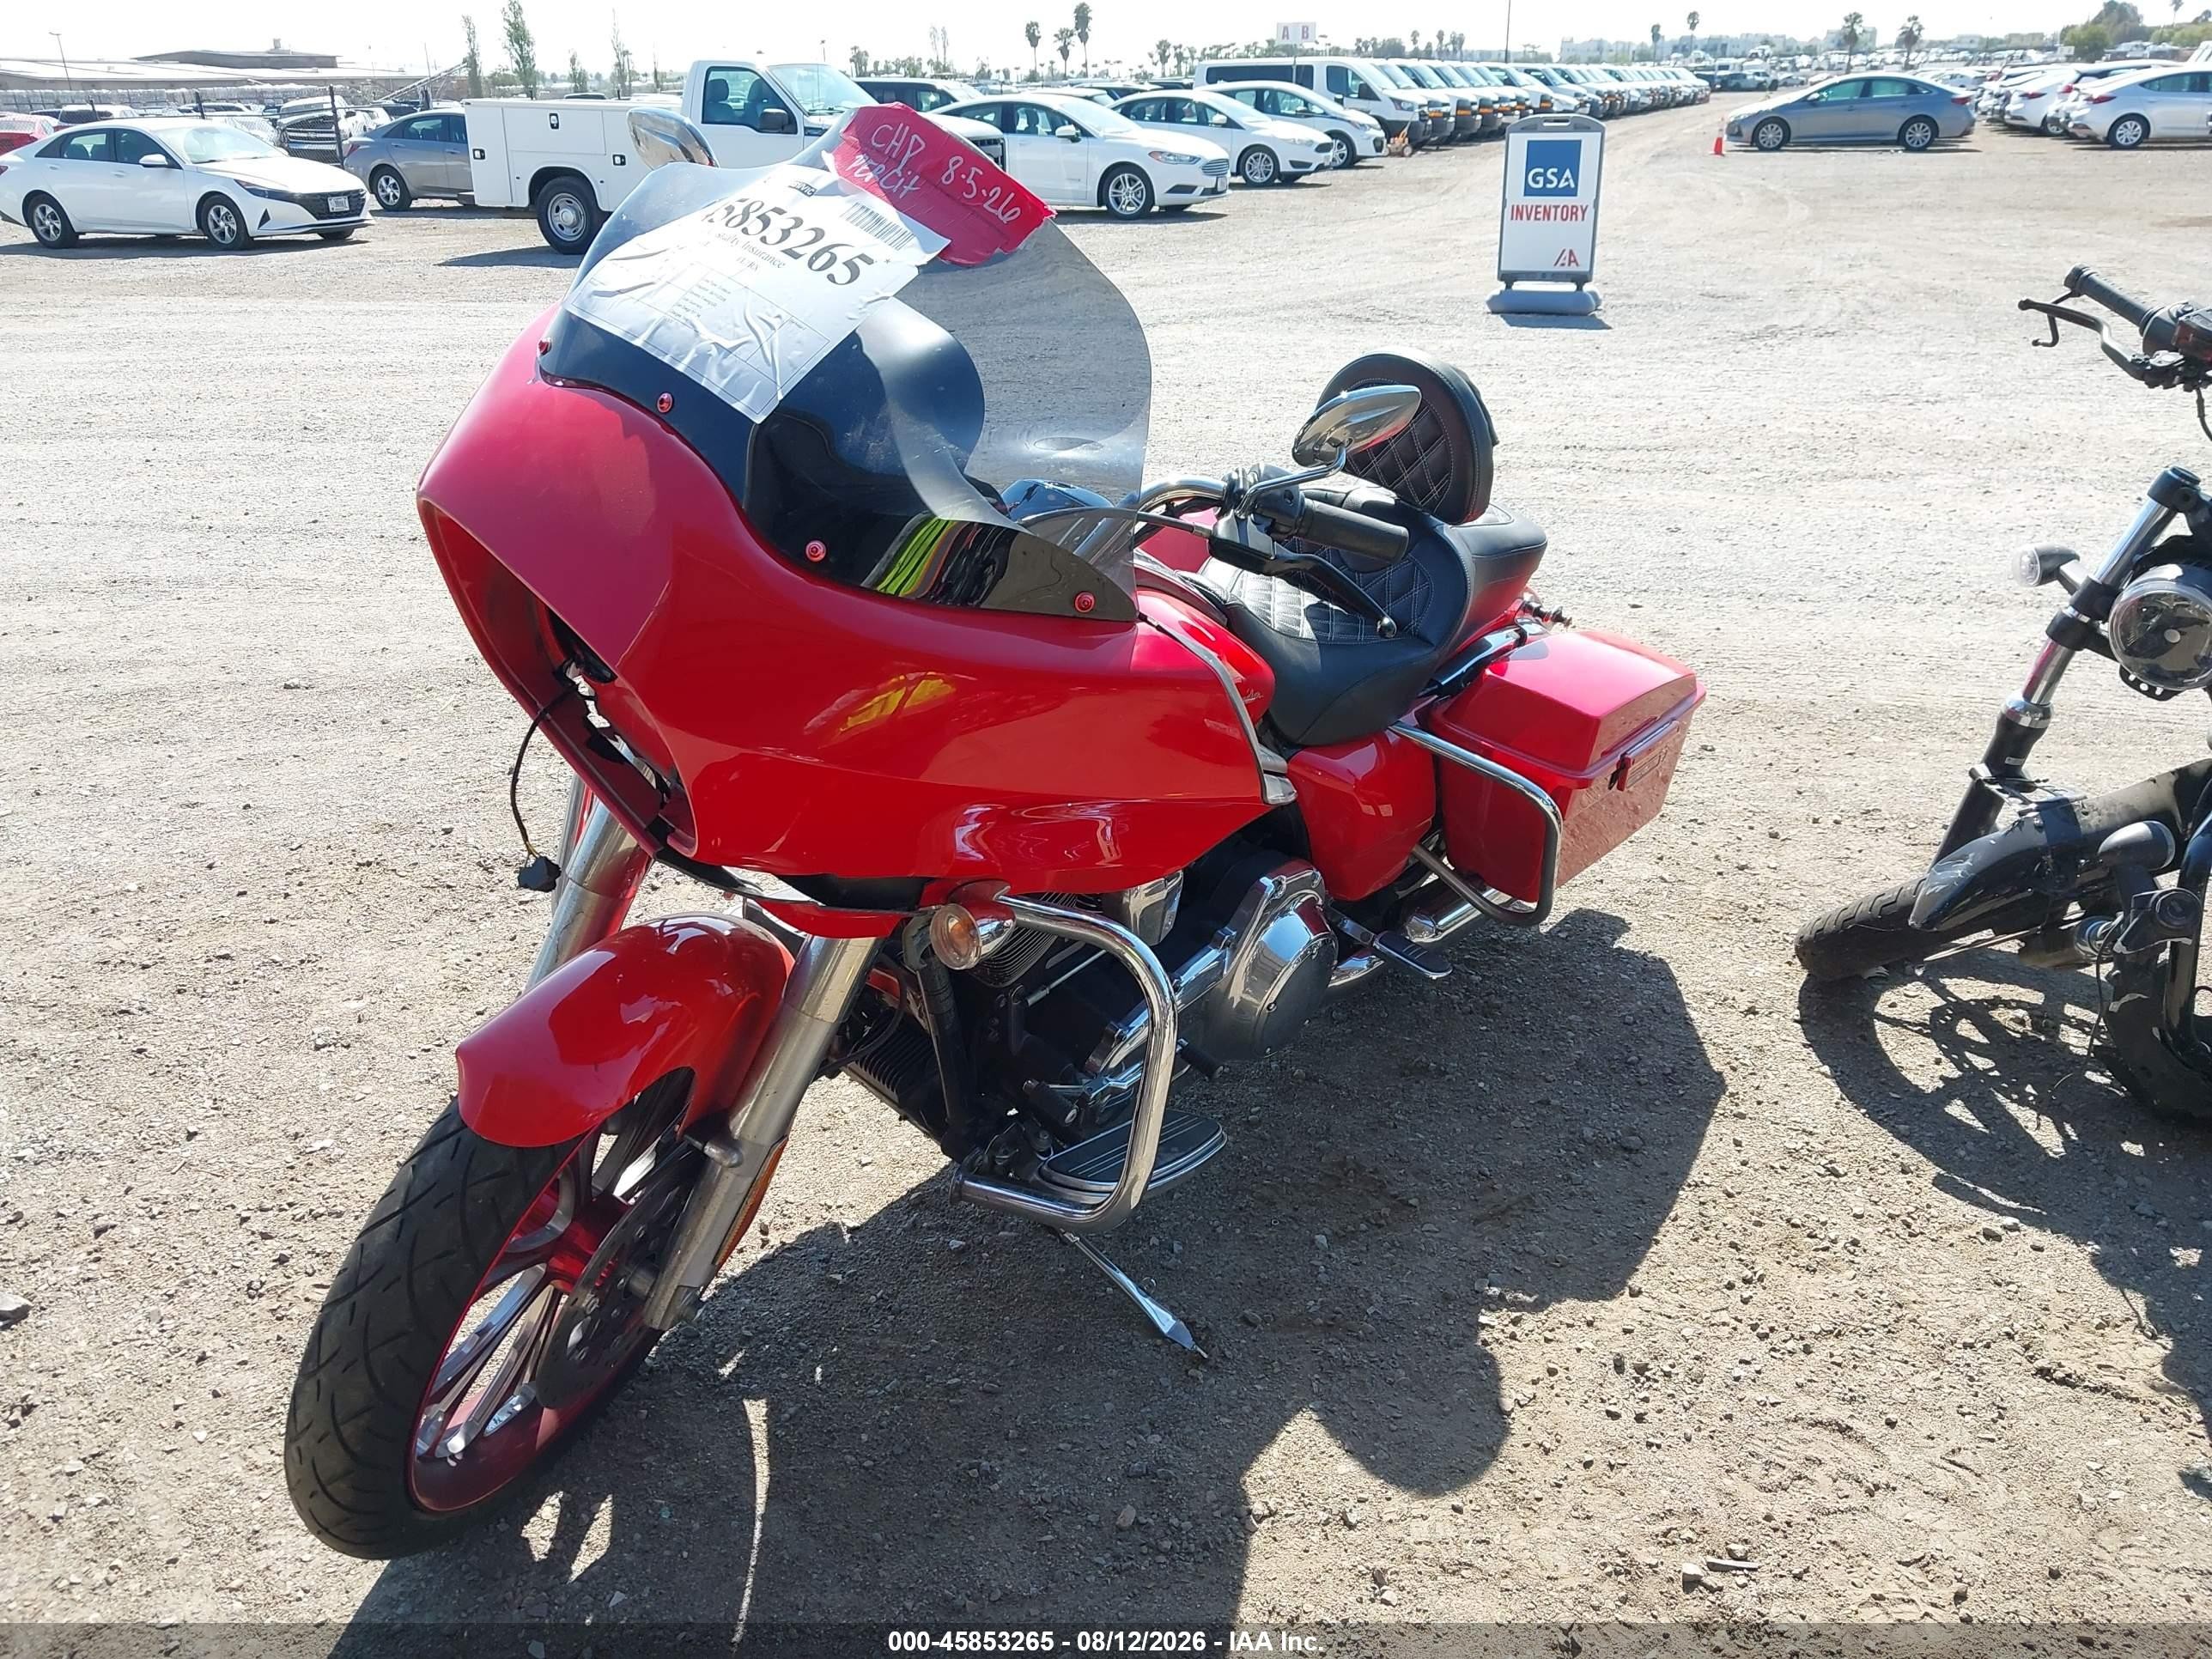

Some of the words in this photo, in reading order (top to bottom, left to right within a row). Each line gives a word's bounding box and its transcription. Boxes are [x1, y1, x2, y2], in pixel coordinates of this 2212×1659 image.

[1281, 26, 1290, 40] A
[1301, 25, 1310, 40] B
[871, 123, 926, 173] CHP
[1528, 167, 1576, 189] GSA
[1510, 204, 1589, 222] INVENTORY
[702, 198, 875, 286] 5853265
[741, 240, 786, 269] Insurance
